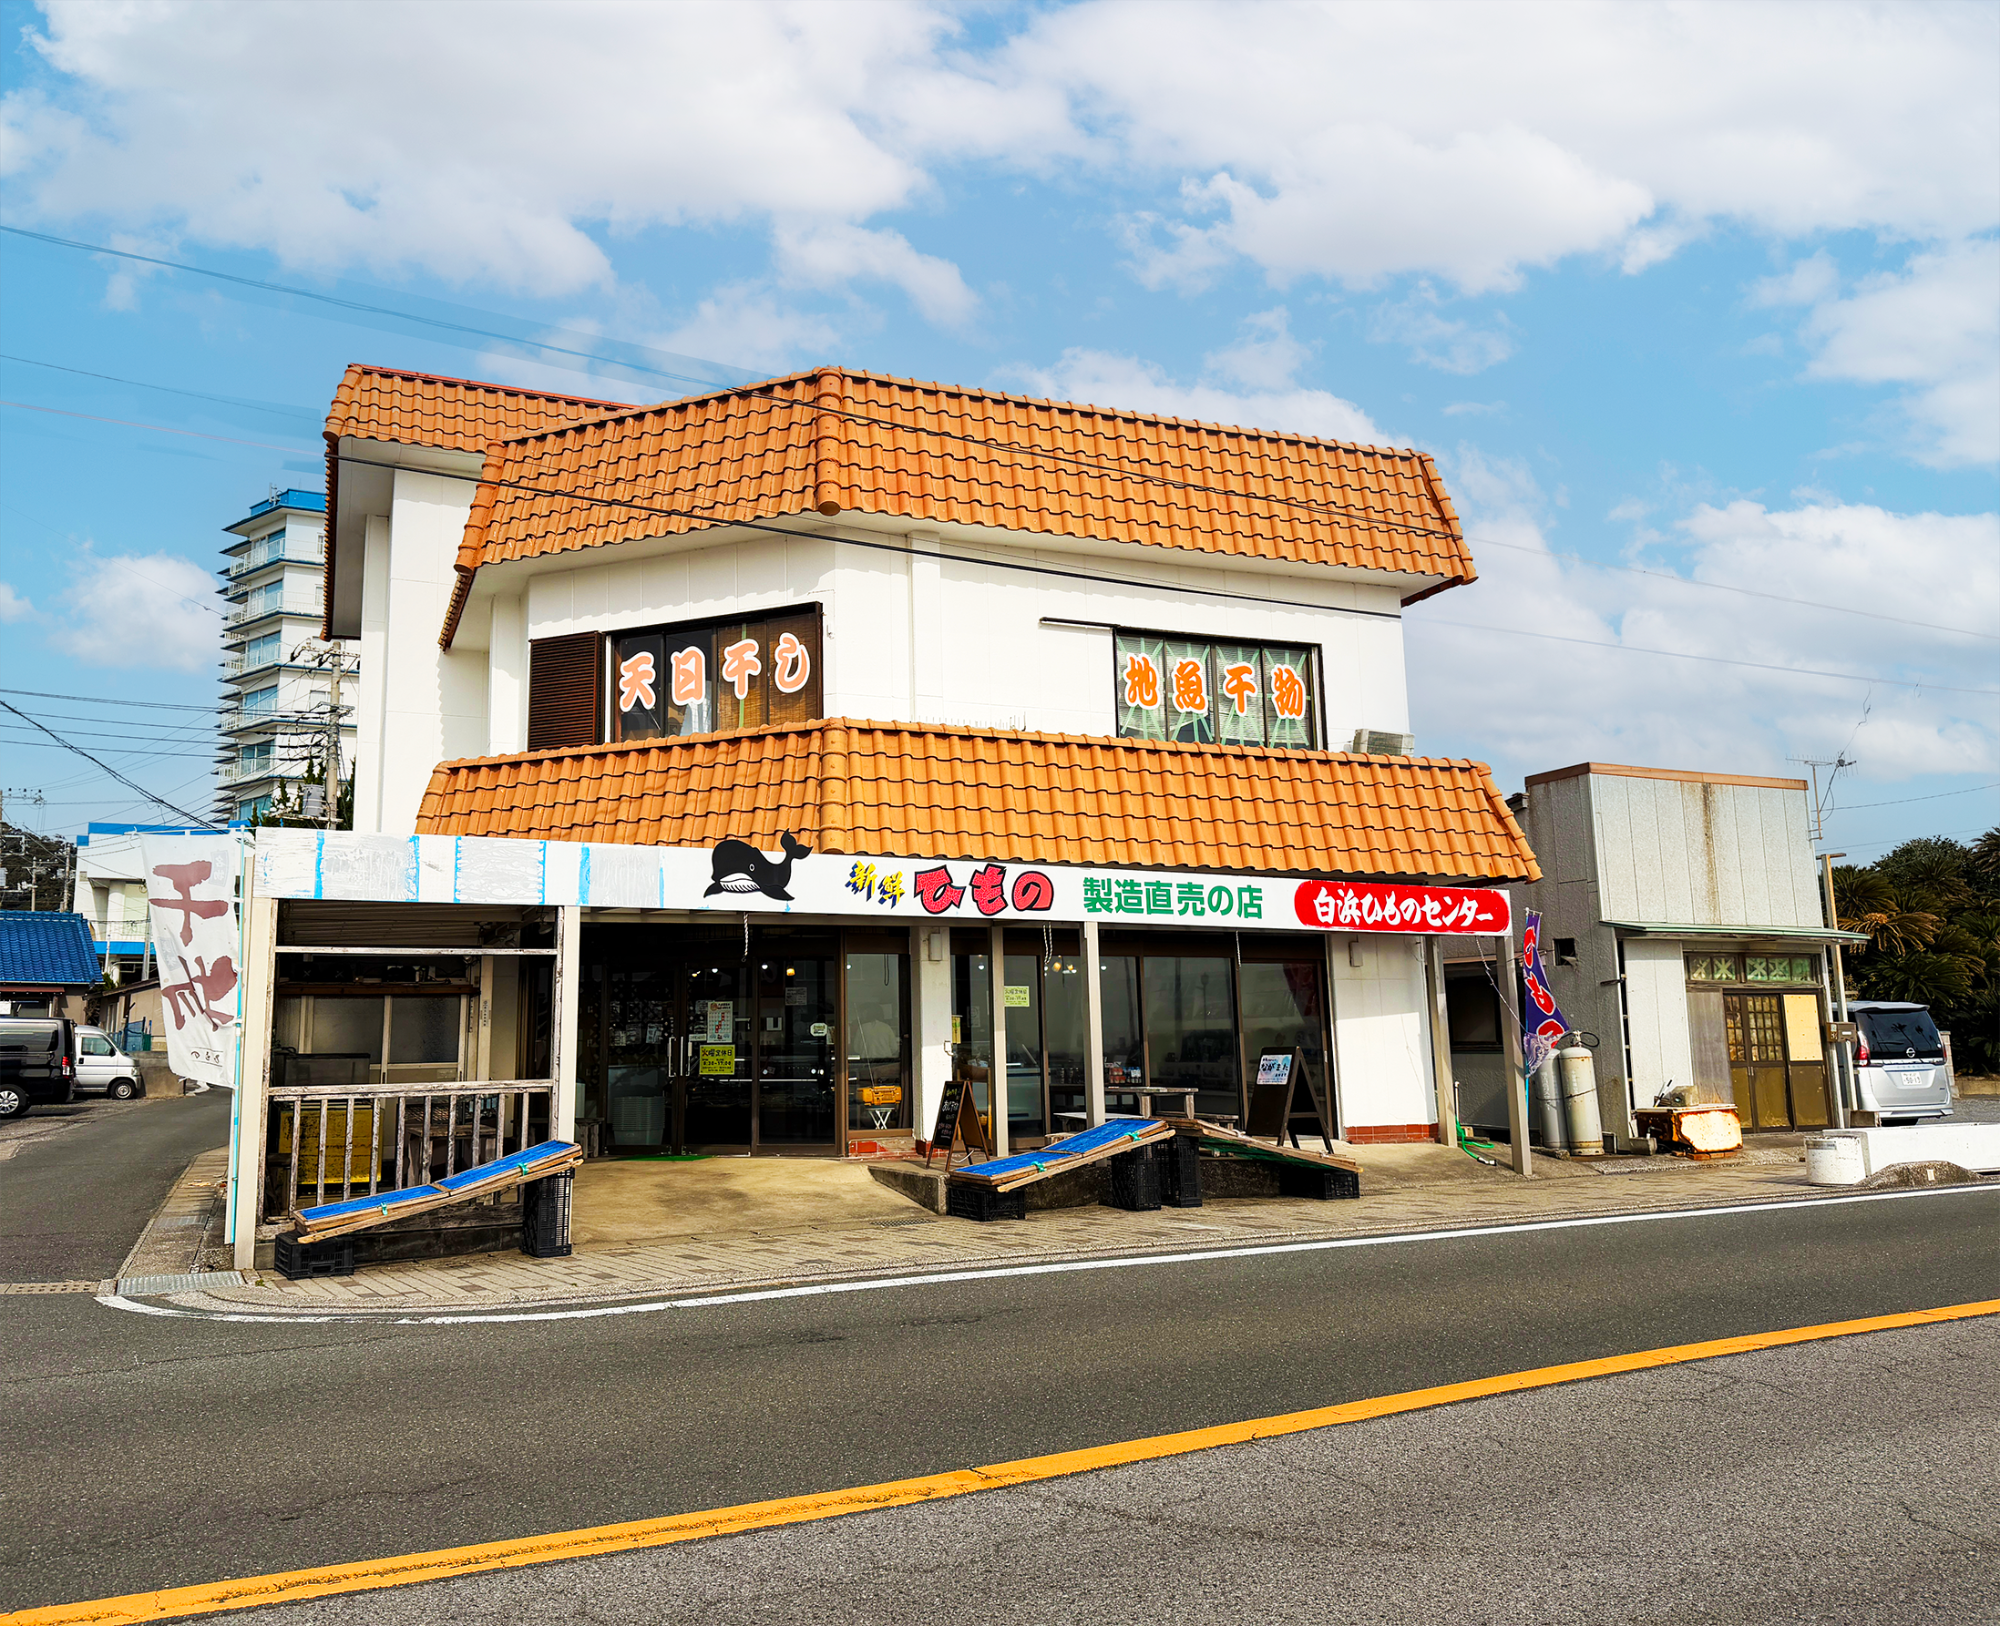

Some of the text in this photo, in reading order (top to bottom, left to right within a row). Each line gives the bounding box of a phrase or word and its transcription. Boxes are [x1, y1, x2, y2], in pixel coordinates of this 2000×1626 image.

[620, 632, 810, 712] 天日干し
[1124, 653, 1306, 720] 地魚干物
[845, 860, 1494, 927] 新鮮 ひもの 製造直売の店 白浜ひものセンター
